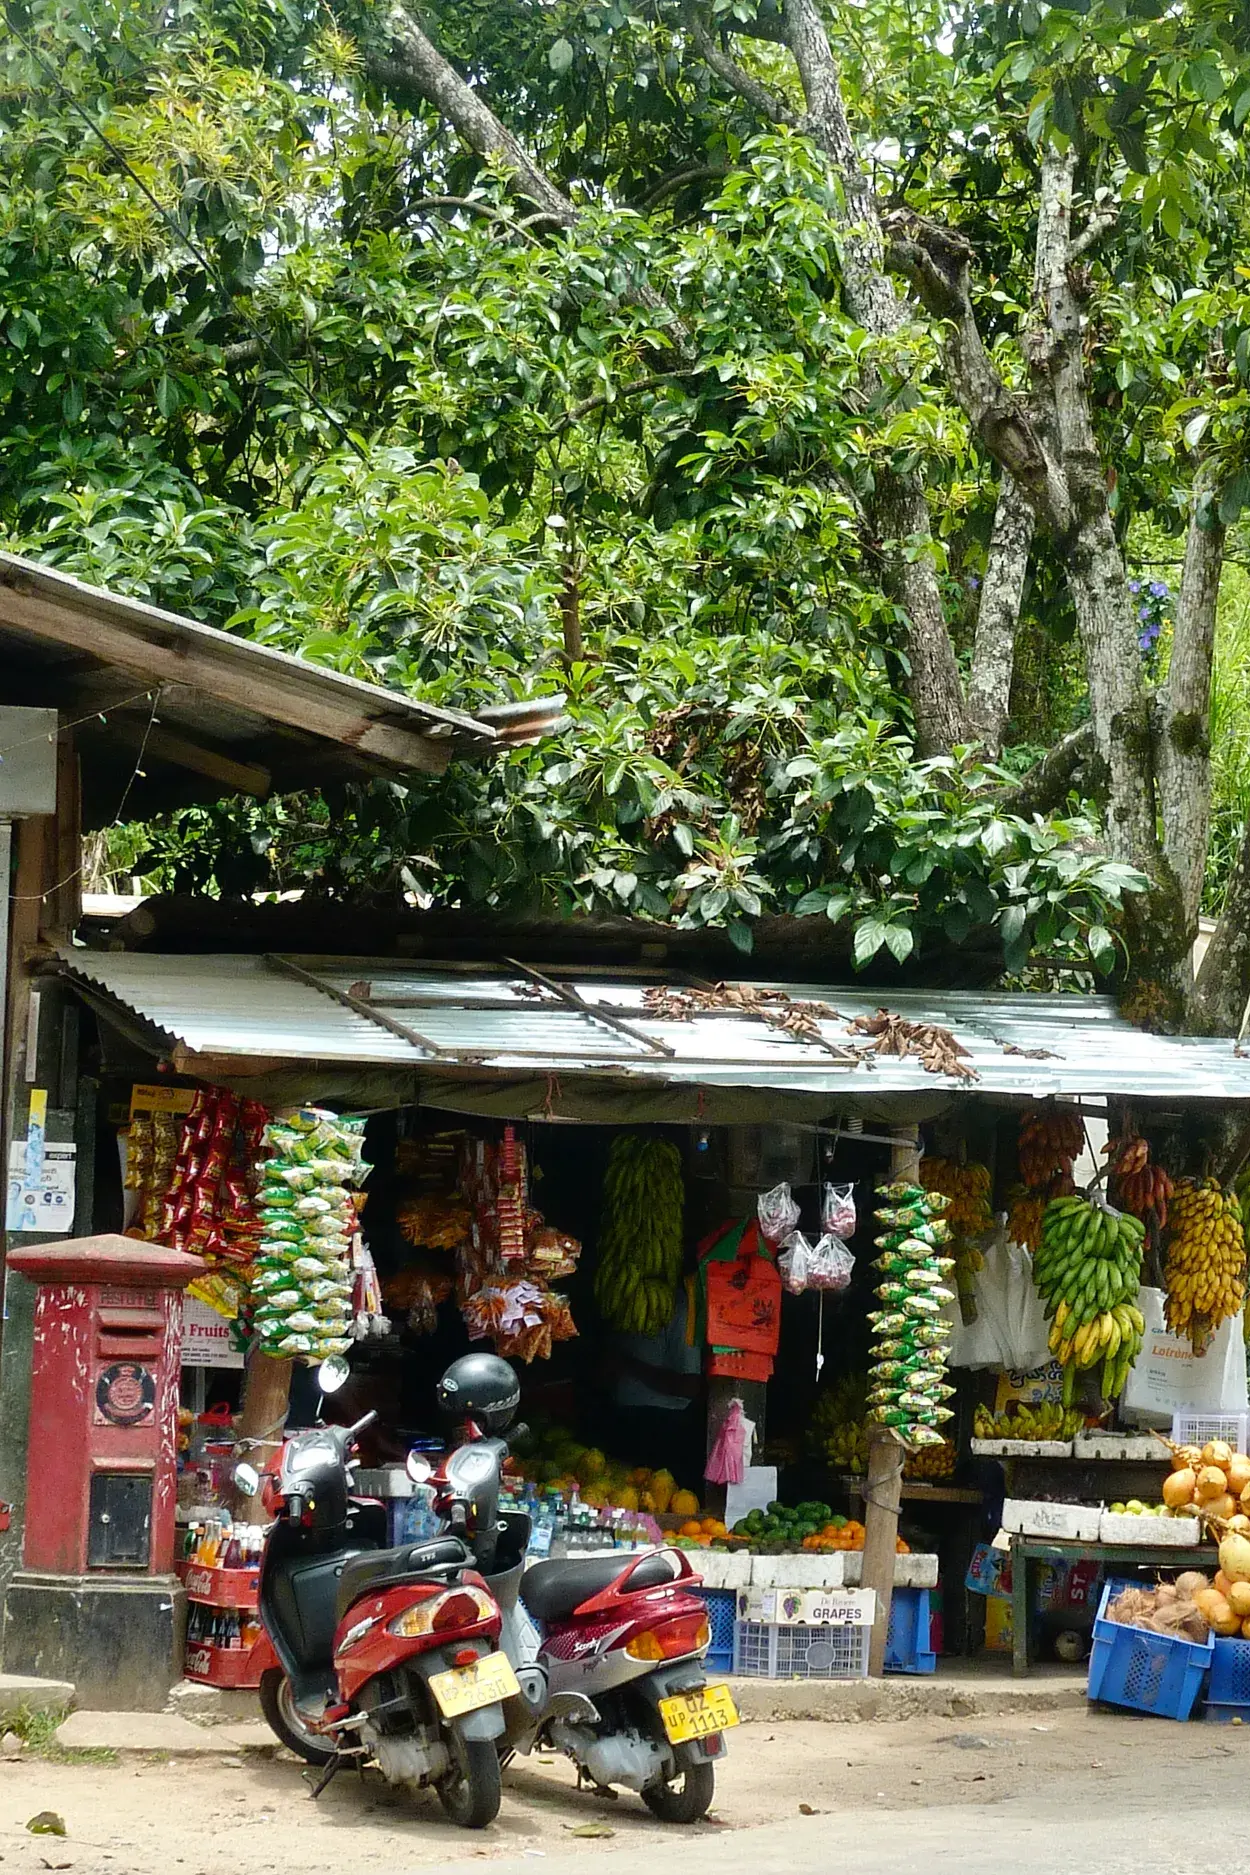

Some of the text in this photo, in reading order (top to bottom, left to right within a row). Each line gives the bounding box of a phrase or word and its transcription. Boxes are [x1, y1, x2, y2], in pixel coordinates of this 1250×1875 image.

[189, 1323, 230, 1338] Fruits
[812, 1608, 862, 1619] GRAPES
[668, 1711, 686, 1728] UP
[689, 1708, 729, 1735] 1113
